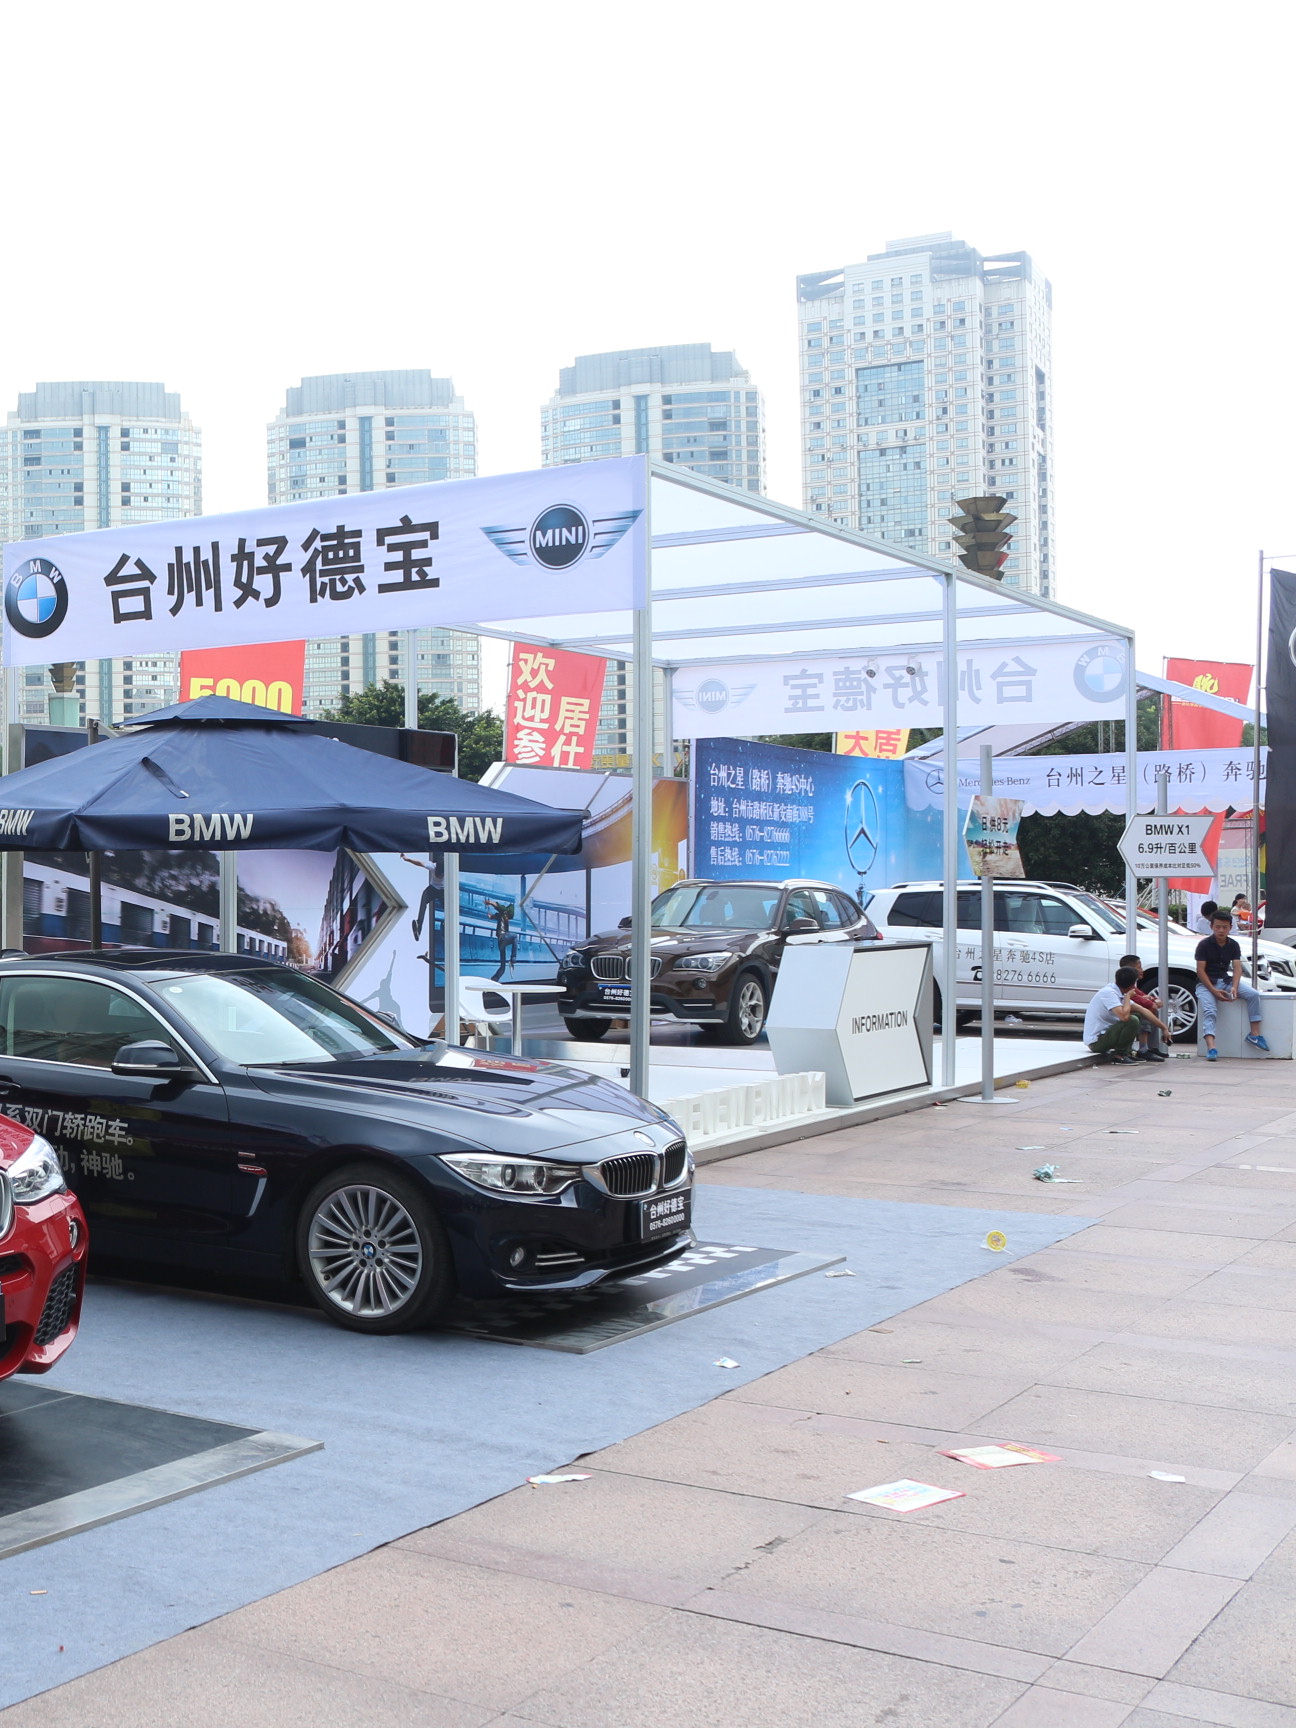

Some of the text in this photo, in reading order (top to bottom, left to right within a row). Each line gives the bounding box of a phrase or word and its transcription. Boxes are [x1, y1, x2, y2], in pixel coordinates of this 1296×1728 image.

[534, 526, 584, 550] MINI
[10, 559, 62, 588] BMW
[103, 515, 440, 624] 台州好德宝
[959, 777, 1031, 787] Merces-Benz
[168, 813, 254, 842] BMW
[427, 816, 503, 843] BMW
[1145, 824, 1190, 836] BMW X1
[1138, 842, 1197, 854] 6.9升/百公里
[852, 1010, 908, 1035] INFORMATION
[650, 1196, 685, 1219] 台州好德宝
